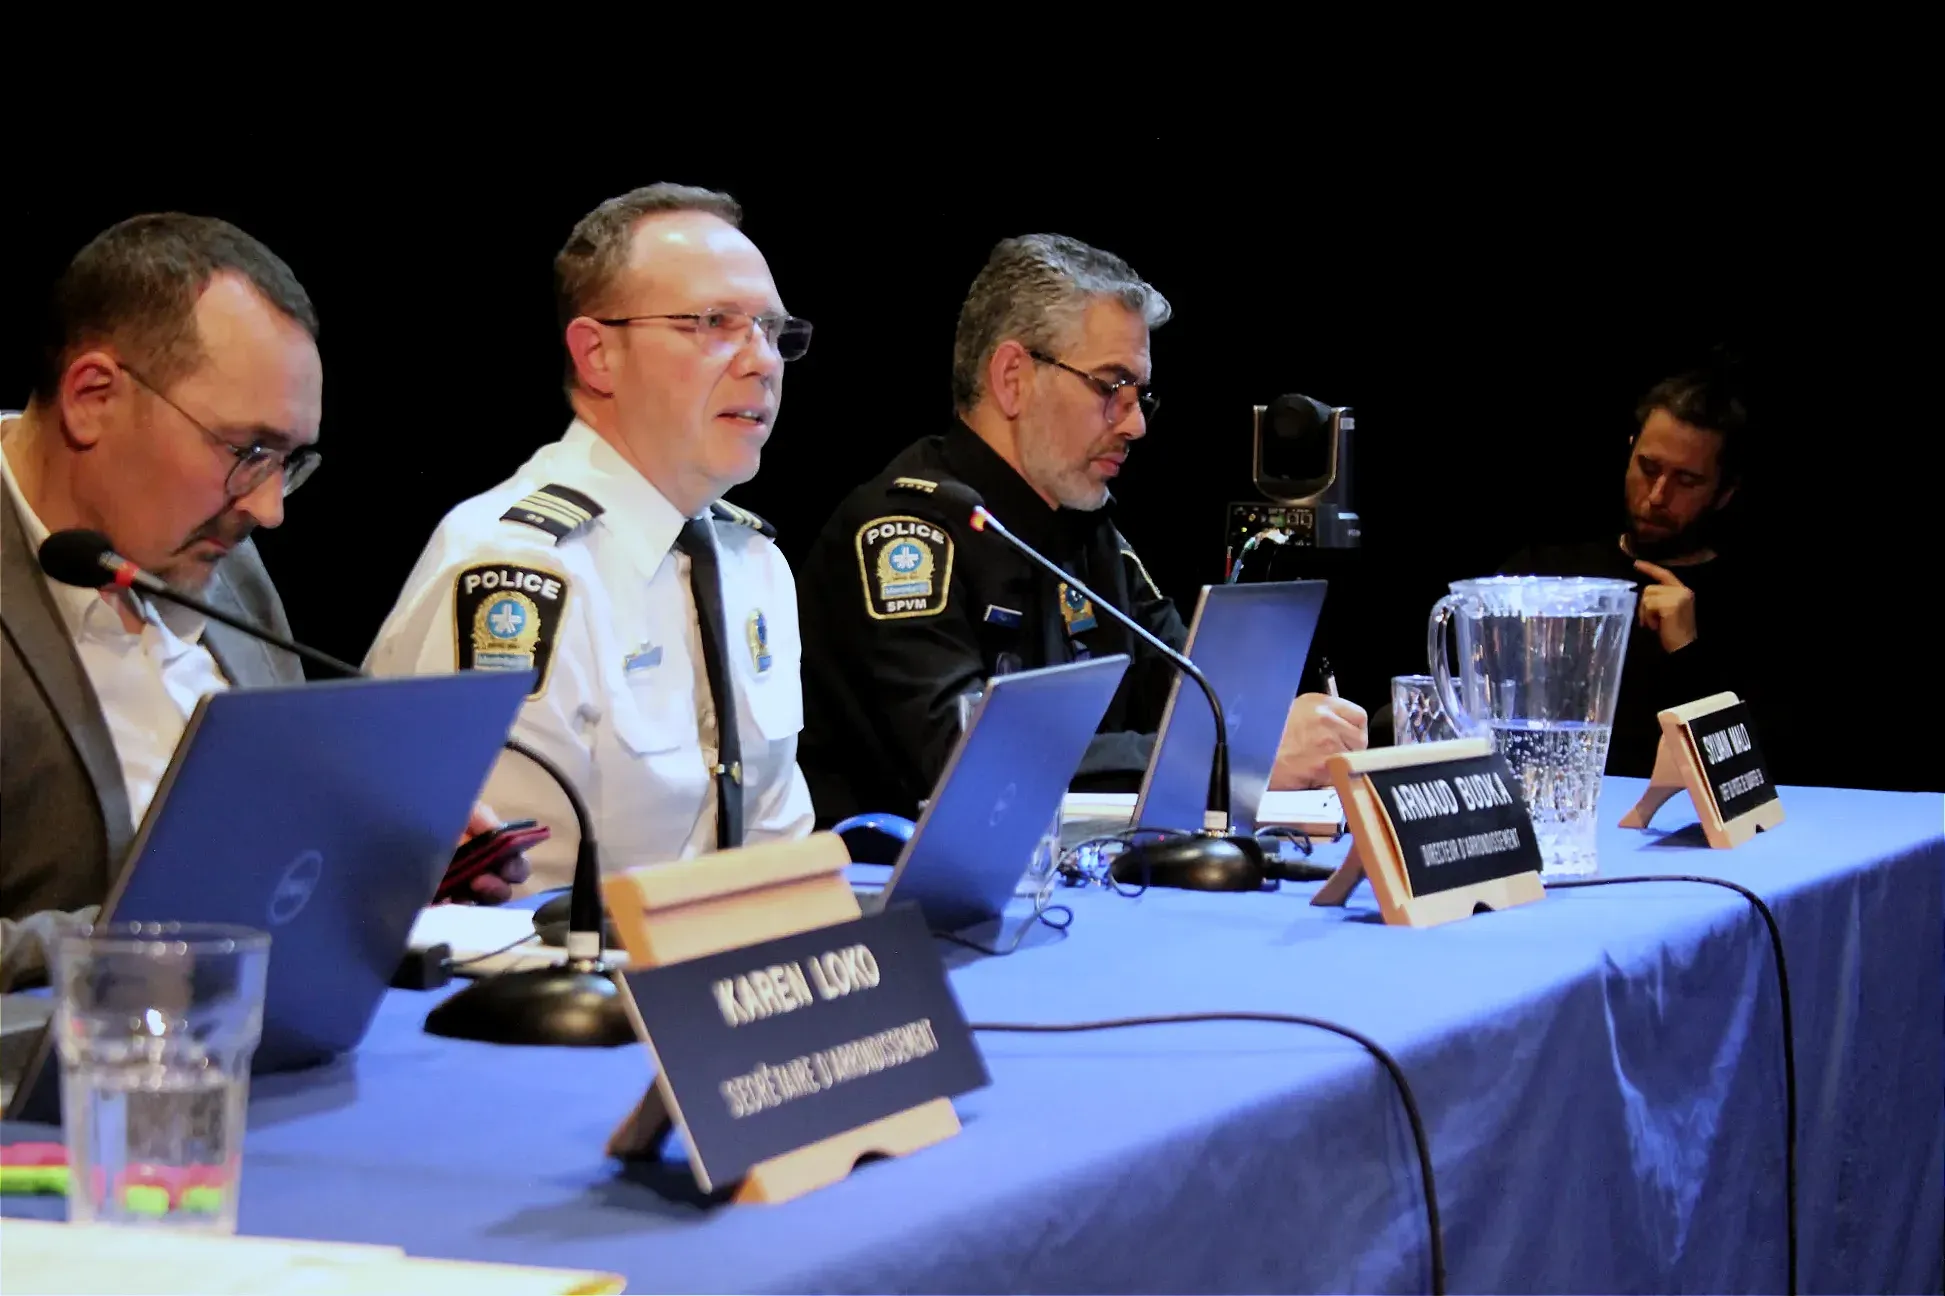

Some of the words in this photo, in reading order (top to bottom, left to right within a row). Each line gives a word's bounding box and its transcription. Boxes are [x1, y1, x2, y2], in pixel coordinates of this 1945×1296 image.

[866, 523, 945, 545] POLICE
[464, 570, 562, 600] POLICE
[886, 598, 927, 612] SPVM
[1390, 779, 1459, 823] ARNAUD
[1453, 771, 1514, 811] BUDKA
[711, 961, 814, 1028] KAREN
[807, 943, 881, 1001] LOKO
[718, 1055, 821, 1119] SECRÉTAIRE
